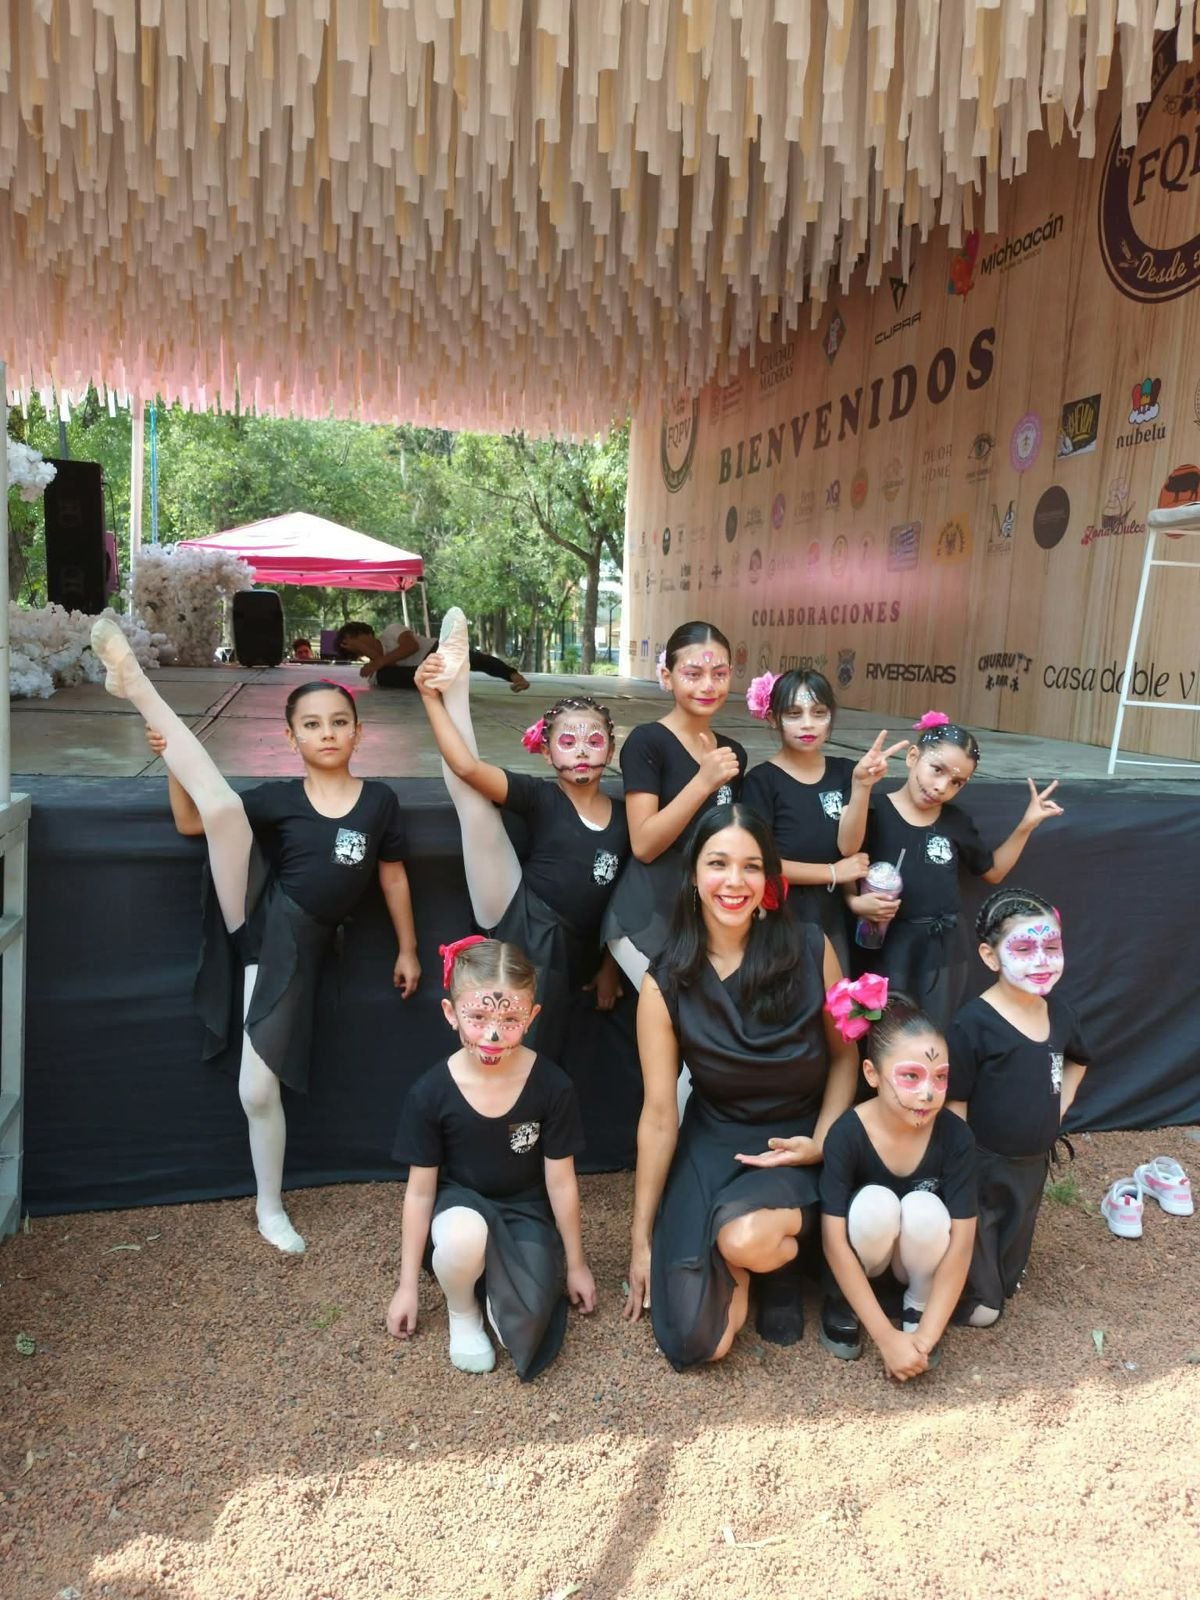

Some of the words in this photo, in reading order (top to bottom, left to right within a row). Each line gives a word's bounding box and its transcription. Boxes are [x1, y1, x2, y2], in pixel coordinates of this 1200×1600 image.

[980, 213, 1064, 276] Michoacán
[1136, 251, 1188, 283] Desde
[874, 311, 922, 345] CUPRA
[718, 327, 996, 485] BIENVENIDOS
[667, 417, 692, 449] FQPV
[1116, 421, 1167, 450] nubelú
[1111, 519, 1146, 536] Dulce
[751, 600, 901, 627] COLABORACIONES
[865, 663, 957, 685] RIVERSTARS
[1043, 664, 1096, 692] casa
